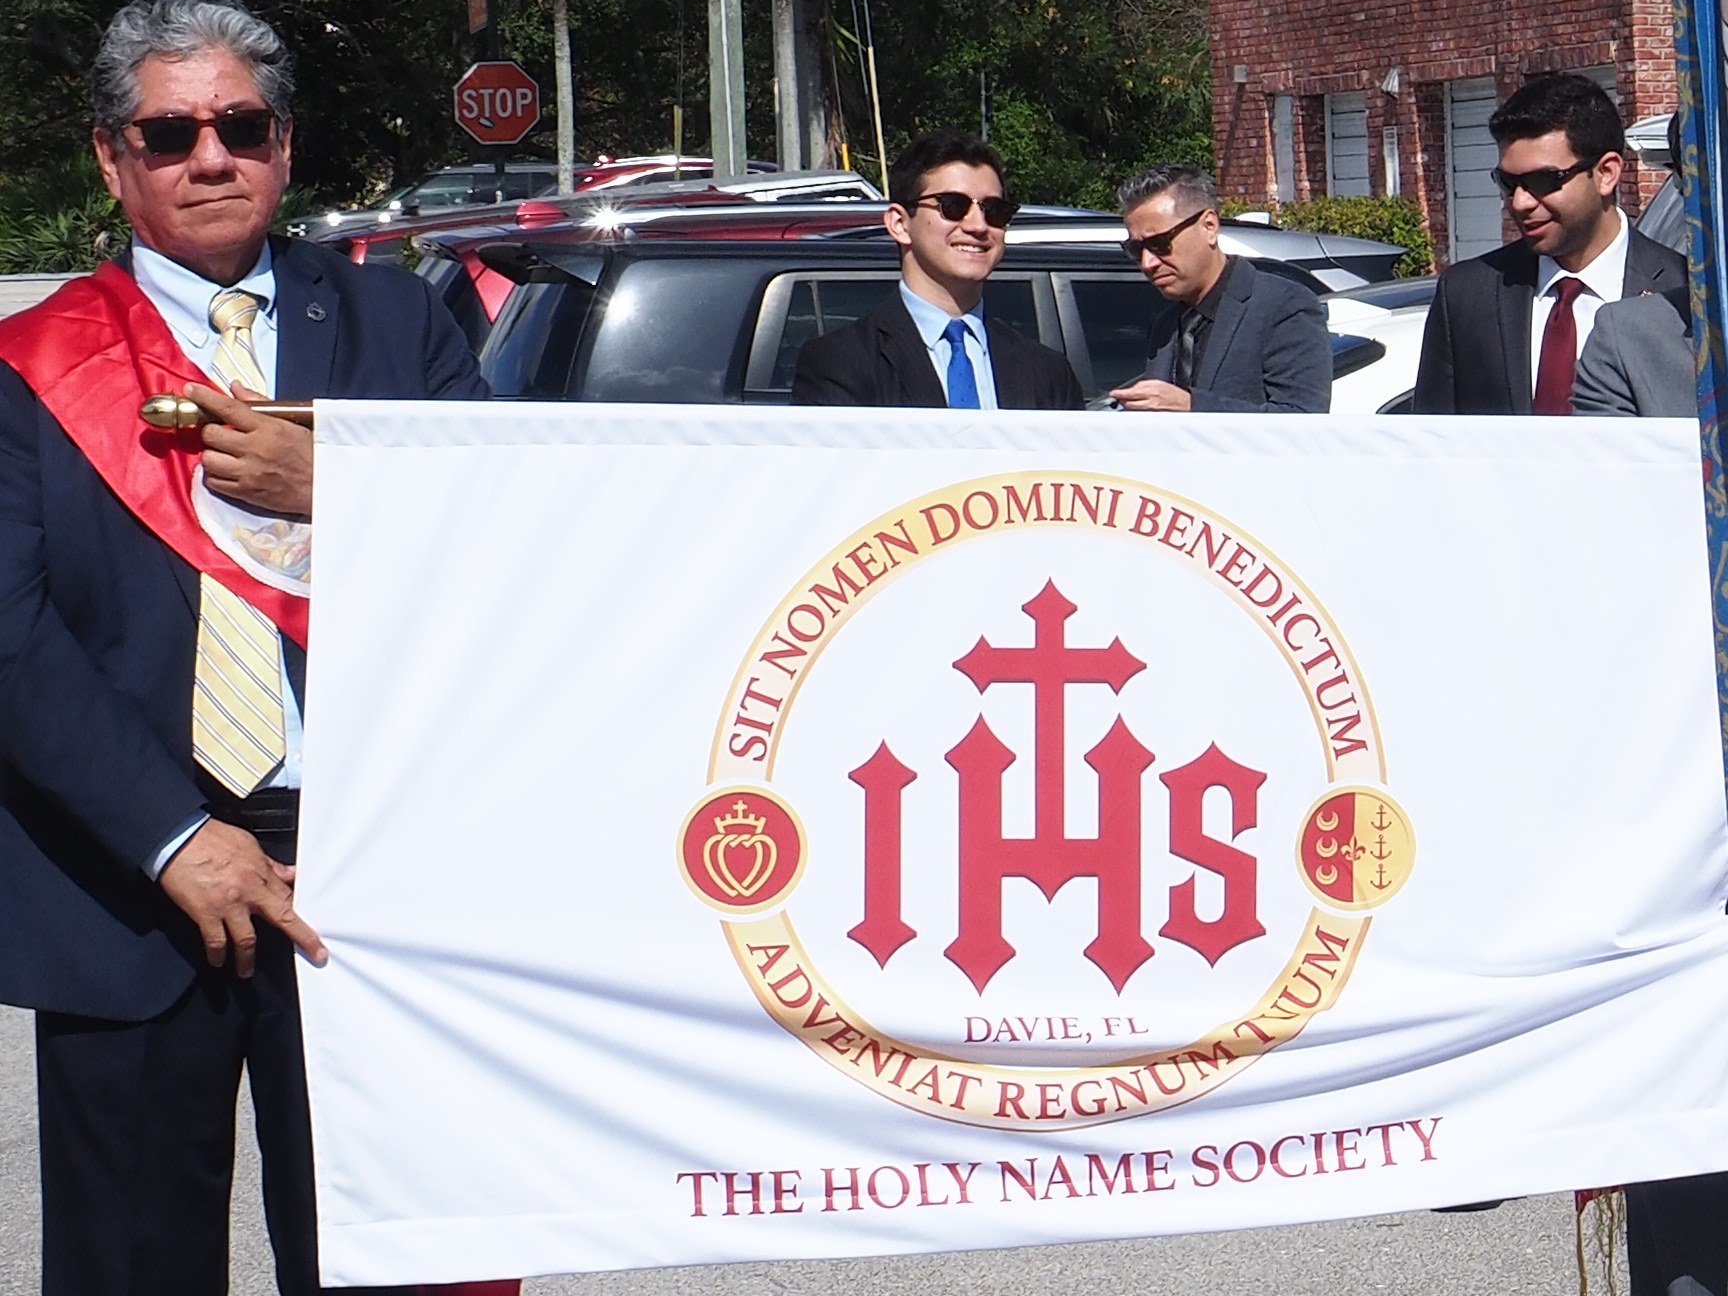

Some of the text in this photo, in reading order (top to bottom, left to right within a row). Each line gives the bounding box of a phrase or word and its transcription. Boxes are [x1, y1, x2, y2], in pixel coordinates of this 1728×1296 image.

[462, 88, 533, 119] STOP
[728, 482, 1369, 762] SIT NOMEN DOMINI BENEDICTUM
[847, 576, 1268, 998] IHS
[746, 942, 983, 1111] ADVENIAT
[993, 1040, 1240, 1120] REGNUM
[964, 1016, 1149, 1044] DAVIE, FL
[676, 1116, 1444, 1217] THE HOLY NAME SOCIETY
